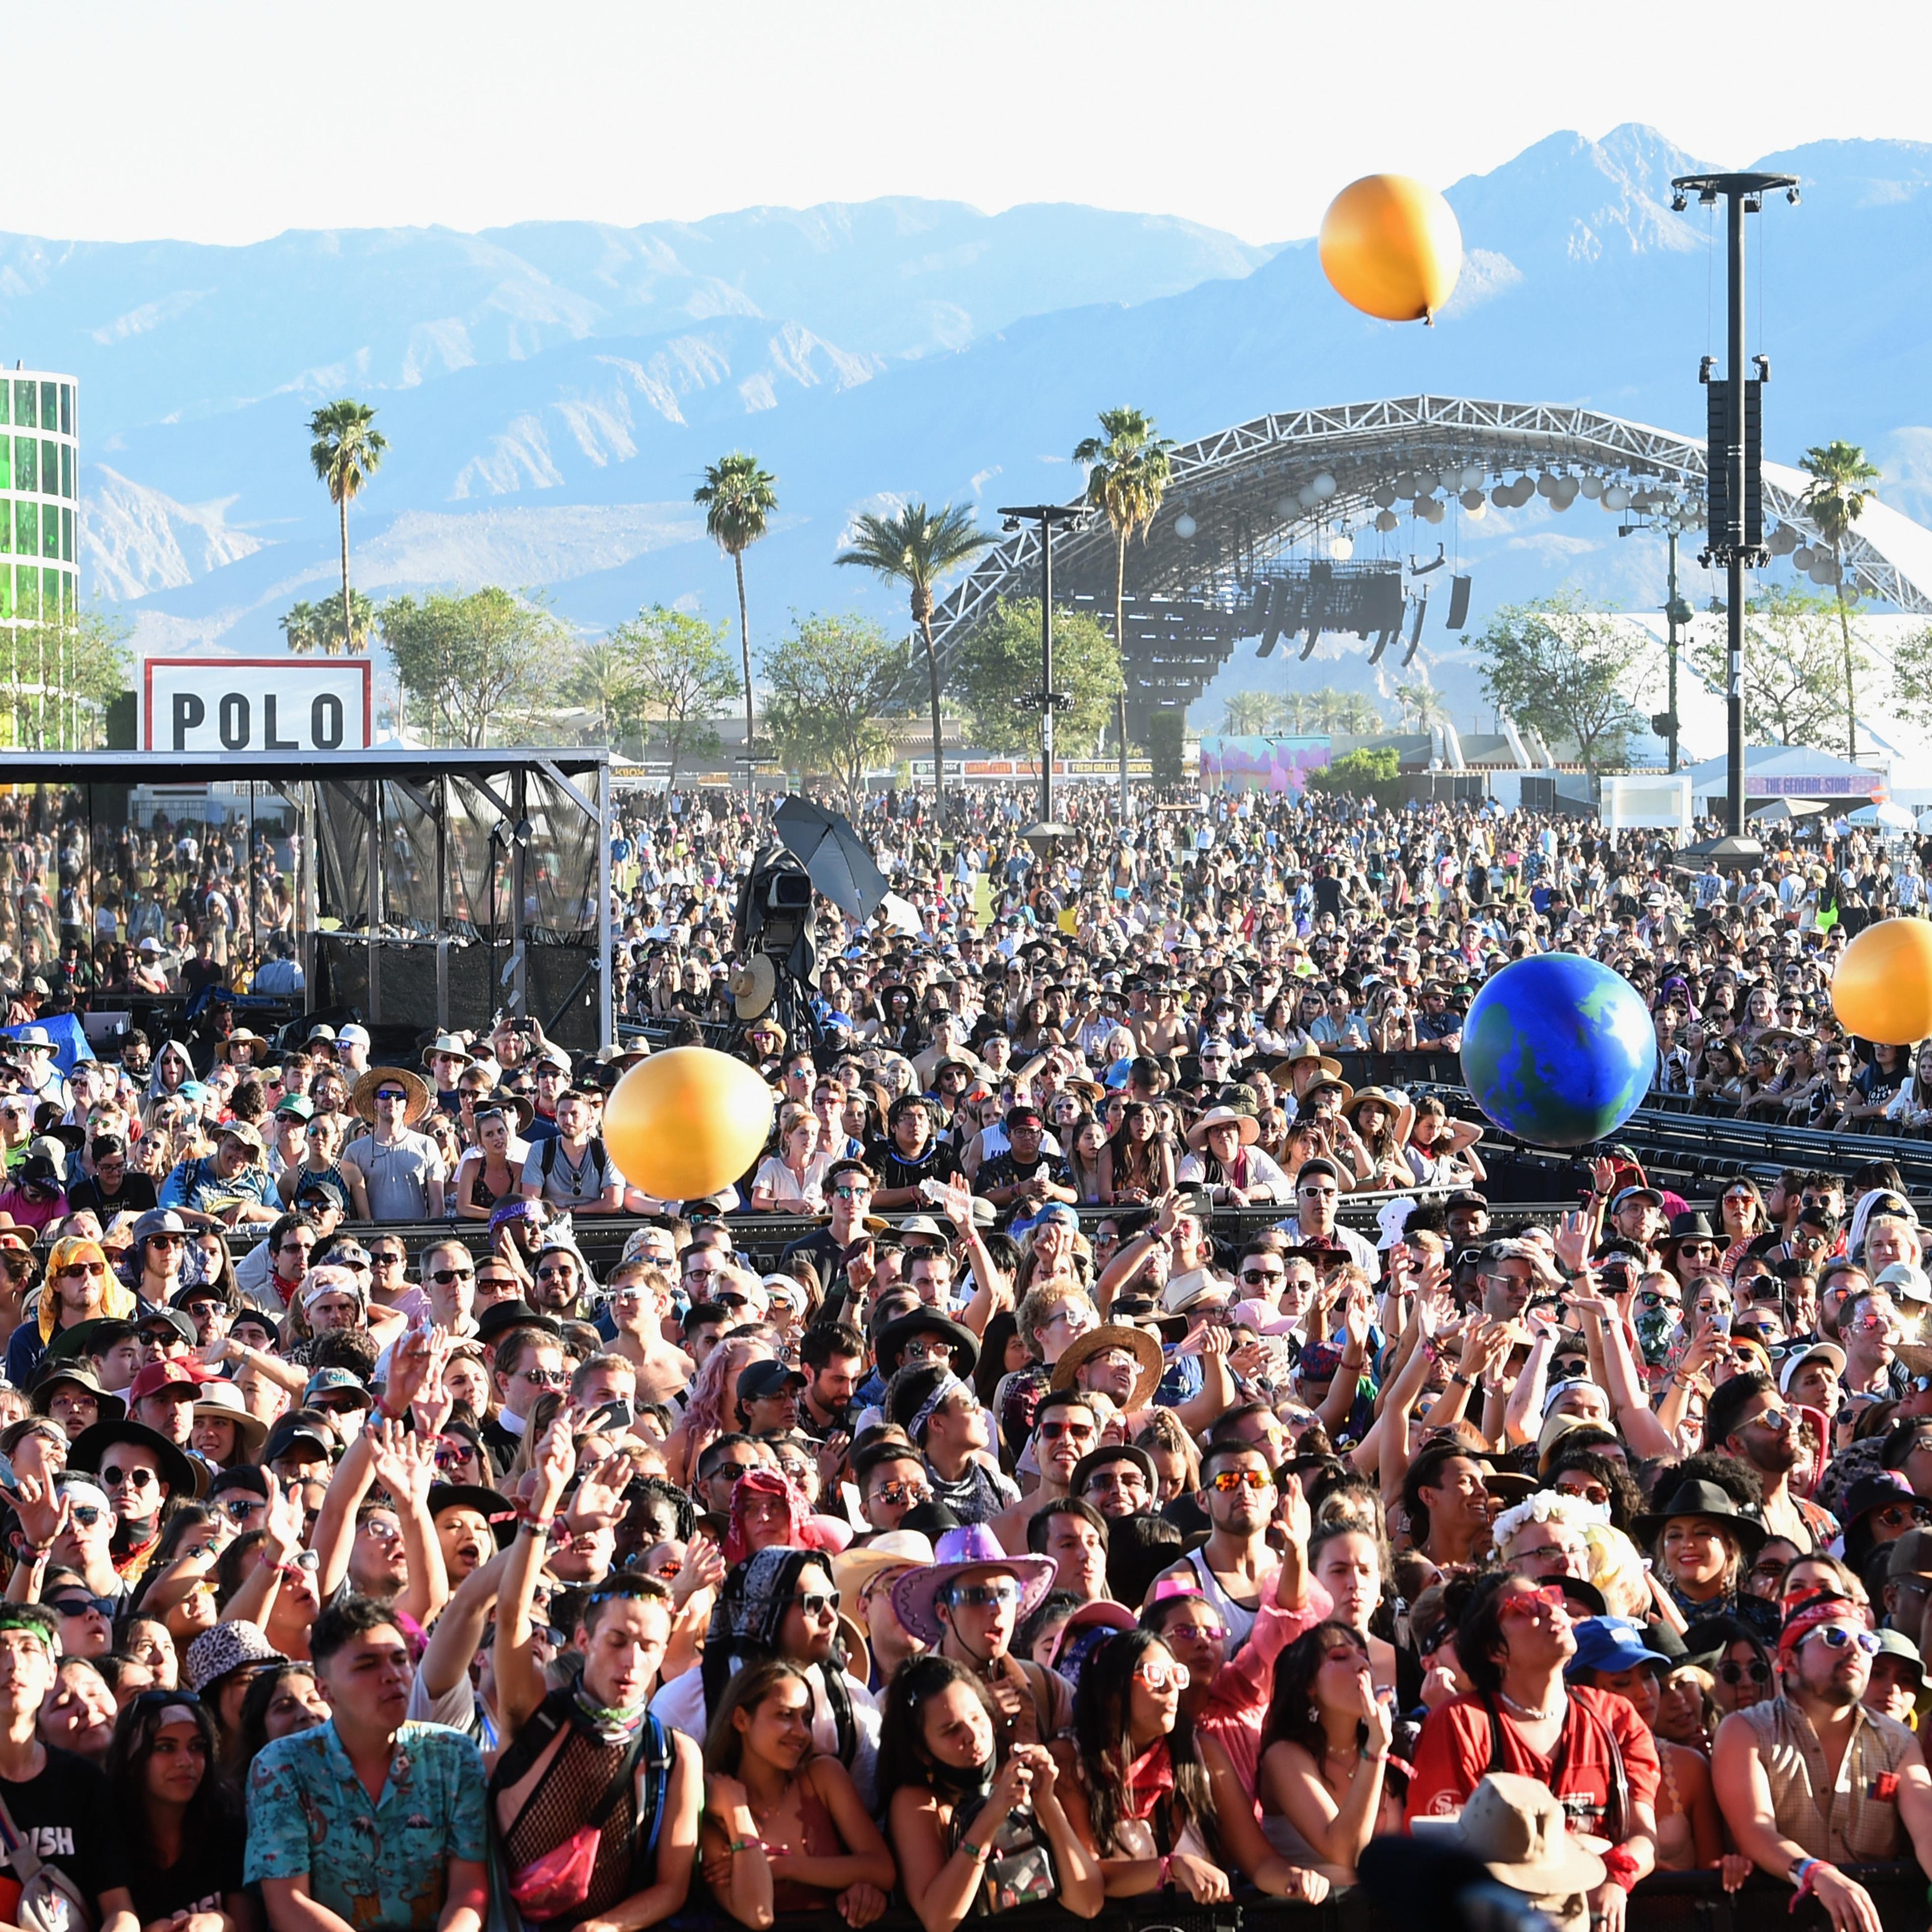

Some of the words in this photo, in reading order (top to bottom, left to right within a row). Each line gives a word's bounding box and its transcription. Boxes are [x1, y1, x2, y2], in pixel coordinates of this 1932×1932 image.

[173, 692, 343, 750] POLO
[1072, 763, 1092, 772] FRESH
[1094, 763, 1119, 772] GRILLED
[1765, 778, 1781, 793] THE
[1784, 778, 1821, 793] GENERAL
[1825, 778, 1852, 793] STORE
